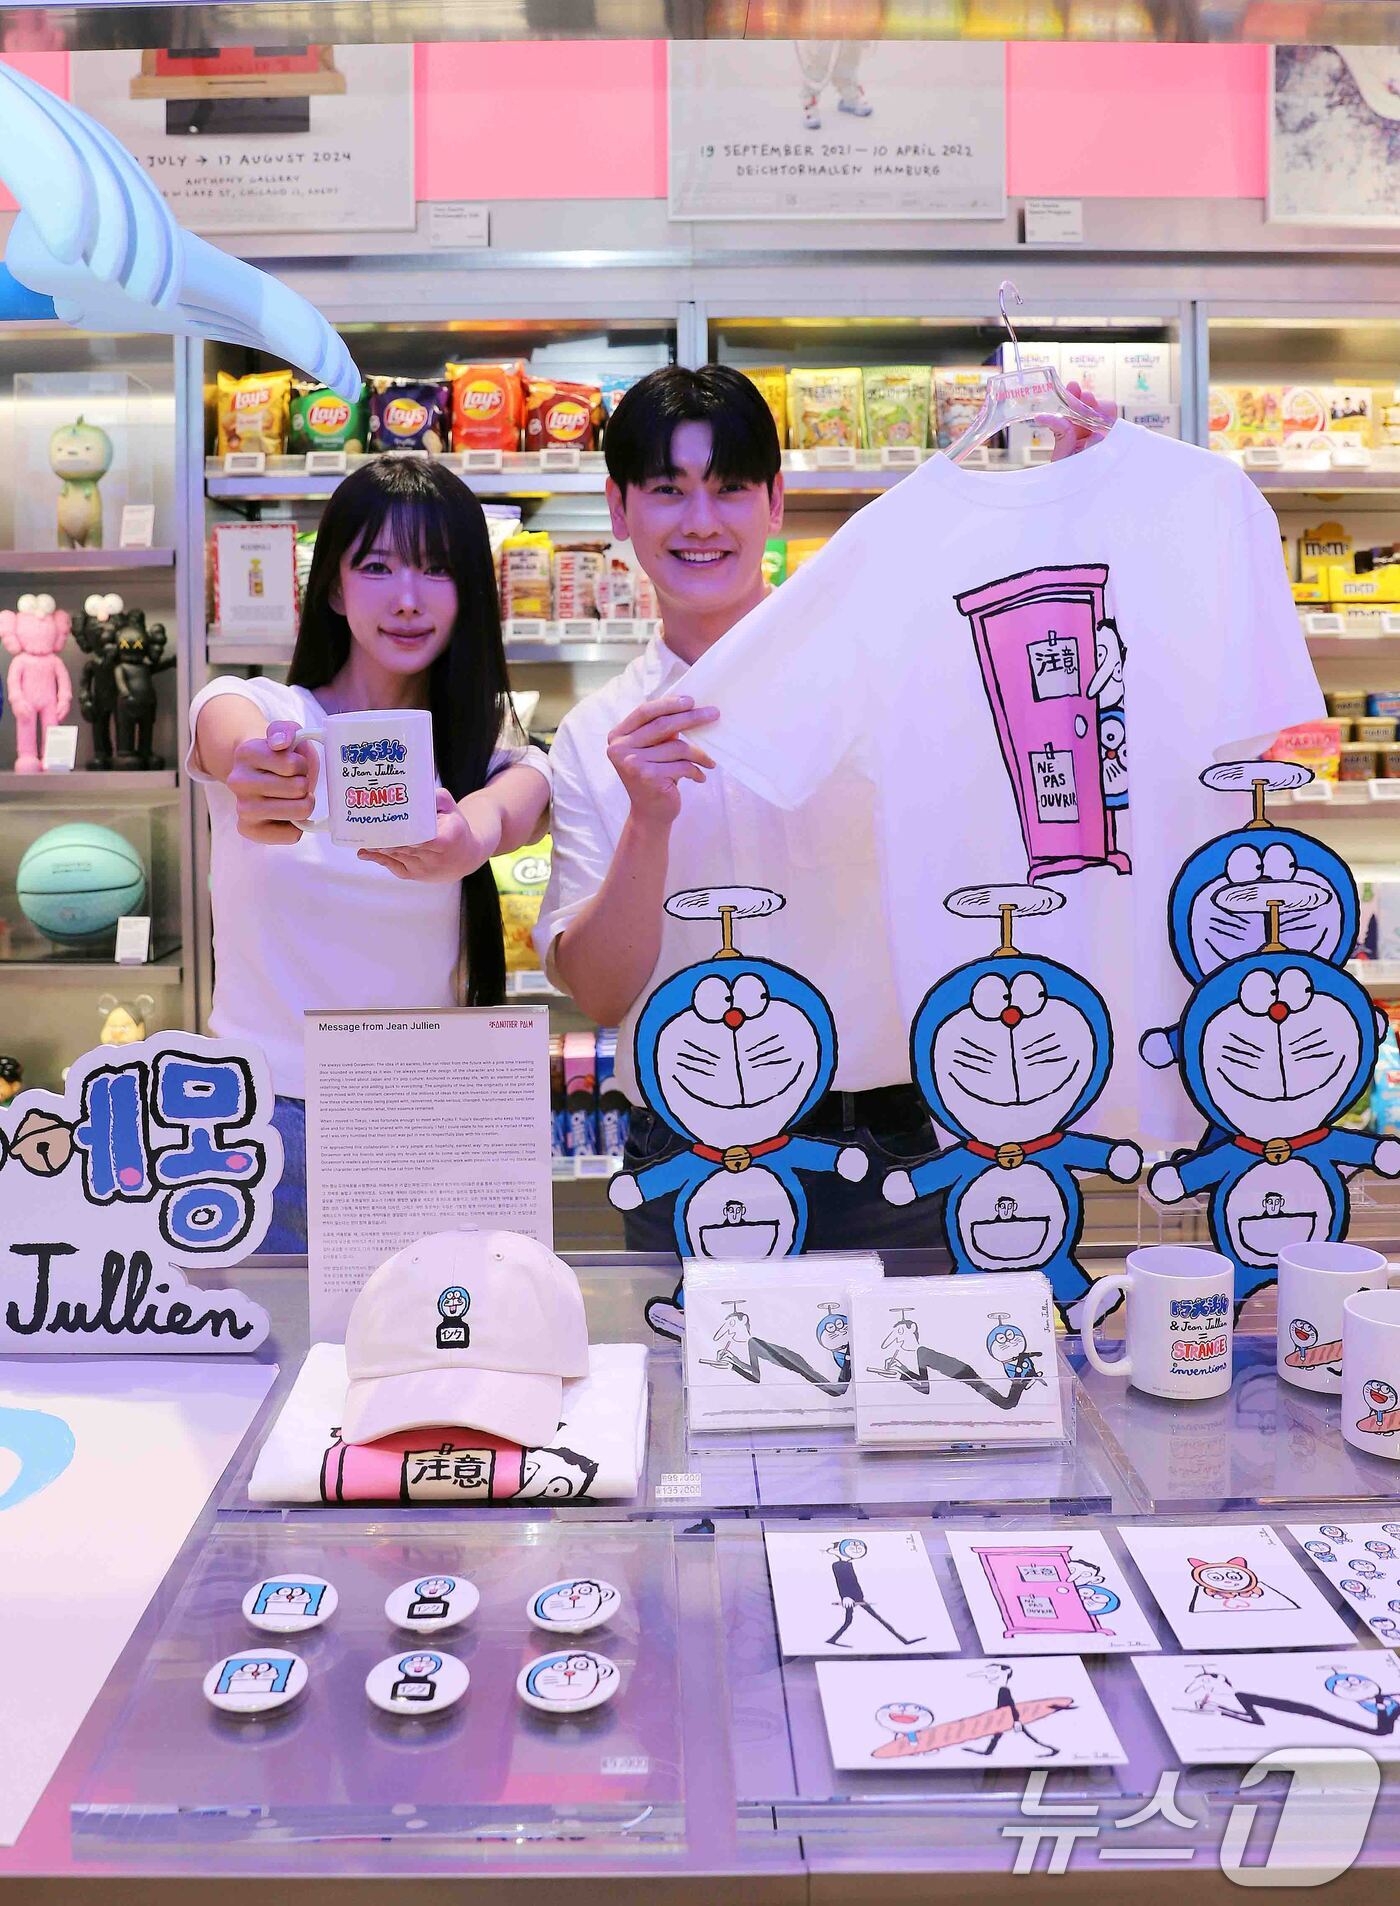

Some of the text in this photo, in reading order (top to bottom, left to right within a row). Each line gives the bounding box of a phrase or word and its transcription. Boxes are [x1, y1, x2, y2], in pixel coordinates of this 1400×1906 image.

[700, 145, 714, 157] 19
[724, 145, 814, 157] SEPTEMBER
[873, 145, 888, 156] 10
[942, 144, 972, 157] 2022
[148, 155, 187, 167] JULY
[240, 153, 305, 165] AUGUST
[313, 152, 352, 163] 2024
[874, 164, 941, 176] HAMBURG
[1035, 645, 1077, 677] 注意
[342, 763, 406, 777] & Jean Jullien
[1037, 761, 1055, 774] NE
[1043, 774, 1066, 788] PAS
[346, 785, 407, 807] STRANGE
[346, 810, 409, 824] inventions
[318, 1020, 440, 1032] Message from Jean Jullien
[495, 1020, 533, 1029] ANOTHER PALM
[0, 1050, 267, 1253] 에몽
[6, 1242, 254, 1340] Jullien
[1170, 1316, 1228, 1331] & Jean Jullien
[441, 1329, 463, 1341] インク
[1171, 1335, 1227, 1360] STRANGE
[1169, 1362, 1228, 1376] inventions
[411, 1454, 489, 1489] 注意
